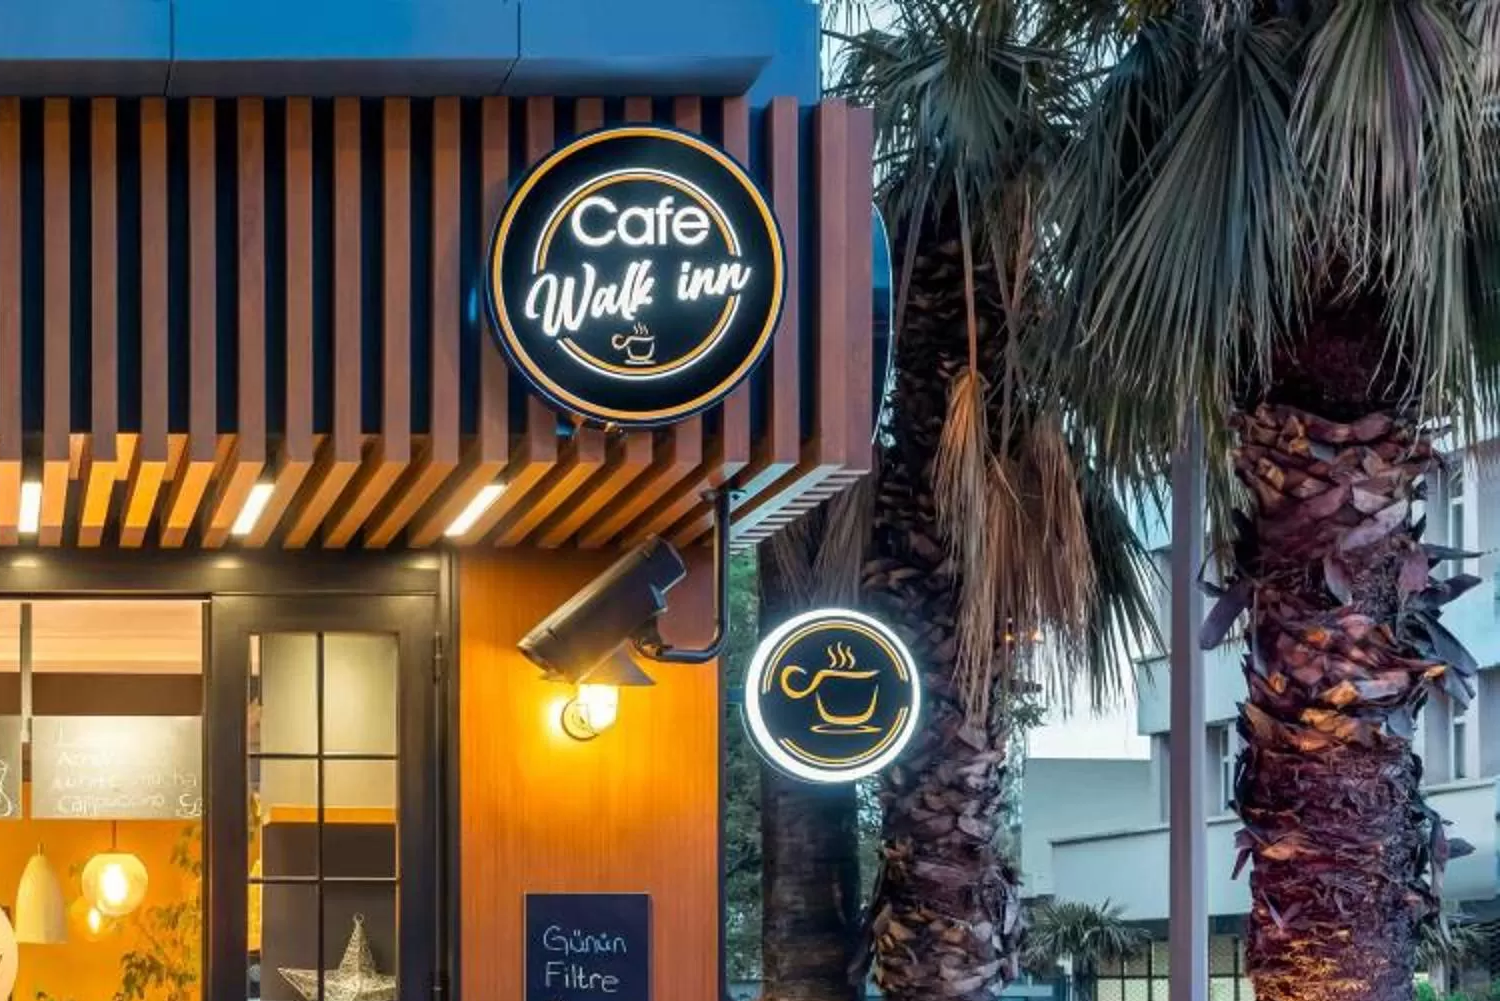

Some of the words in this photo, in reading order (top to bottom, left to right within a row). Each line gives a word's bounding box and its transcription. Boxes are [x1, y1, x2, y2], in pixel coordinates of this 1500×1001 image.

[571, 196, 711, 247] Cafe
[524, 261, 656, 338] Walk
[676, 260, 753, 301] inn
[544, 960, 620, 993] Filtre
